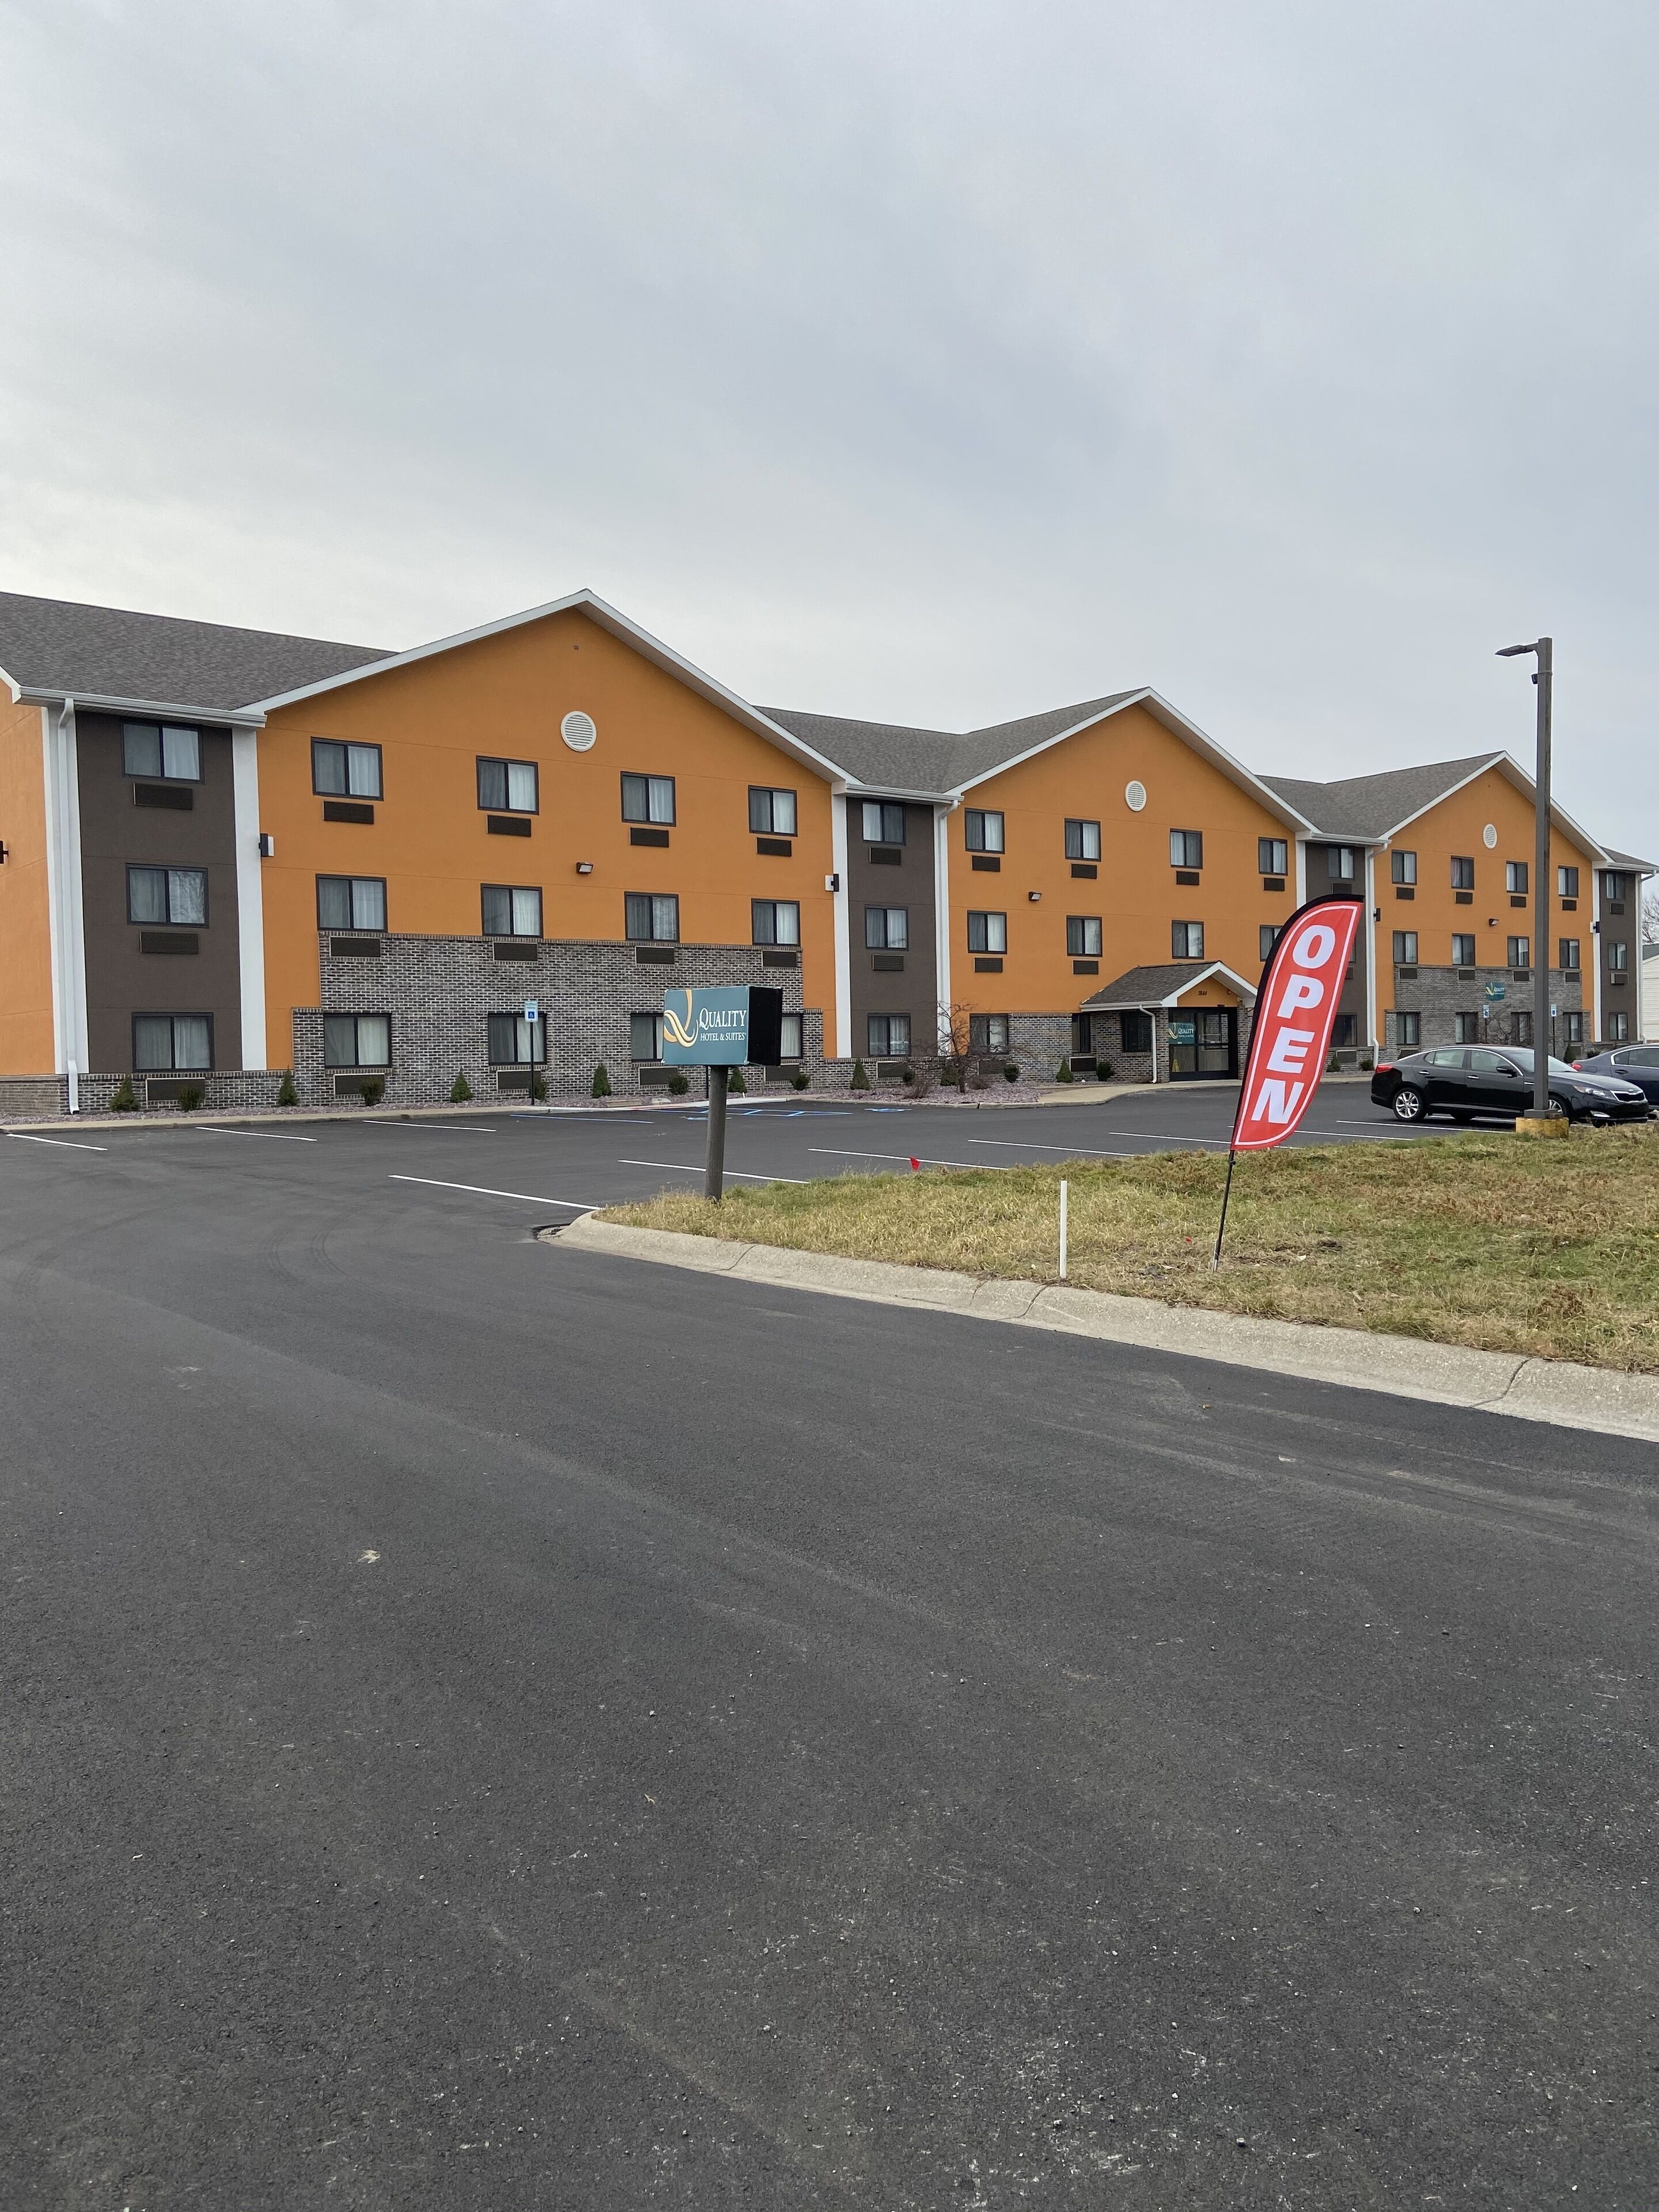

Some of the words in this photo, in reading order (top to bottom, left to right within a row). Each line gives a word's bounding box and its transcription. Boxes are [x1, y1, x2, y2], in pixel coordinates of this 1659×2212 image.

[699, 1007, 747, 1031] QUALITY
[1251, 924, 1336, 1124] OPEN
[700, 1033, 719, 1041] HOTEL
[719, 1033, 725, 1041] &
[725, 1032, 745, 1041] SUITES
